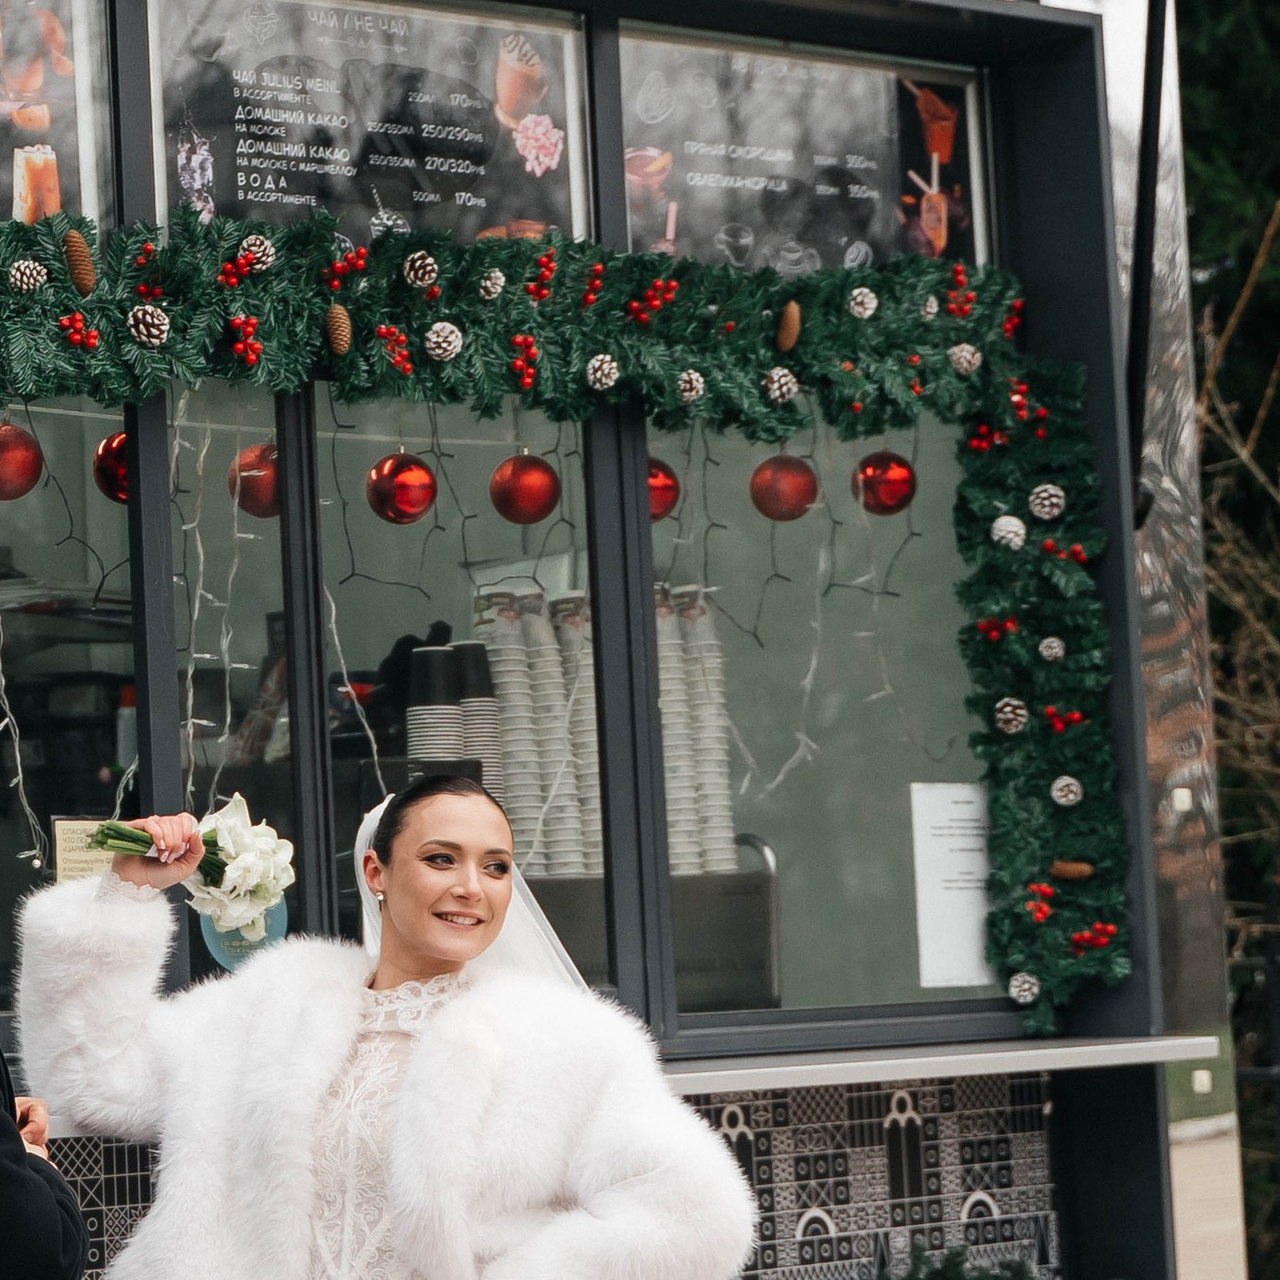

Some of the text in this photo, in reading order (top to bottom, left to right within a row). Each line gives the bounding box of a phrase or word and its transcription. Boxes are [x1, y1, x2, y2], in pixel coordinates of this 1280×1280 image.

[261, 72, 303, 90] JULIUS
[235, 105, 349, 129] ДОМАШНИЙ КАКАО
[236, 138, 350, 162] ДОМАШНИЙ КАКАО
[237, 172, 287, 190] ВОДА
